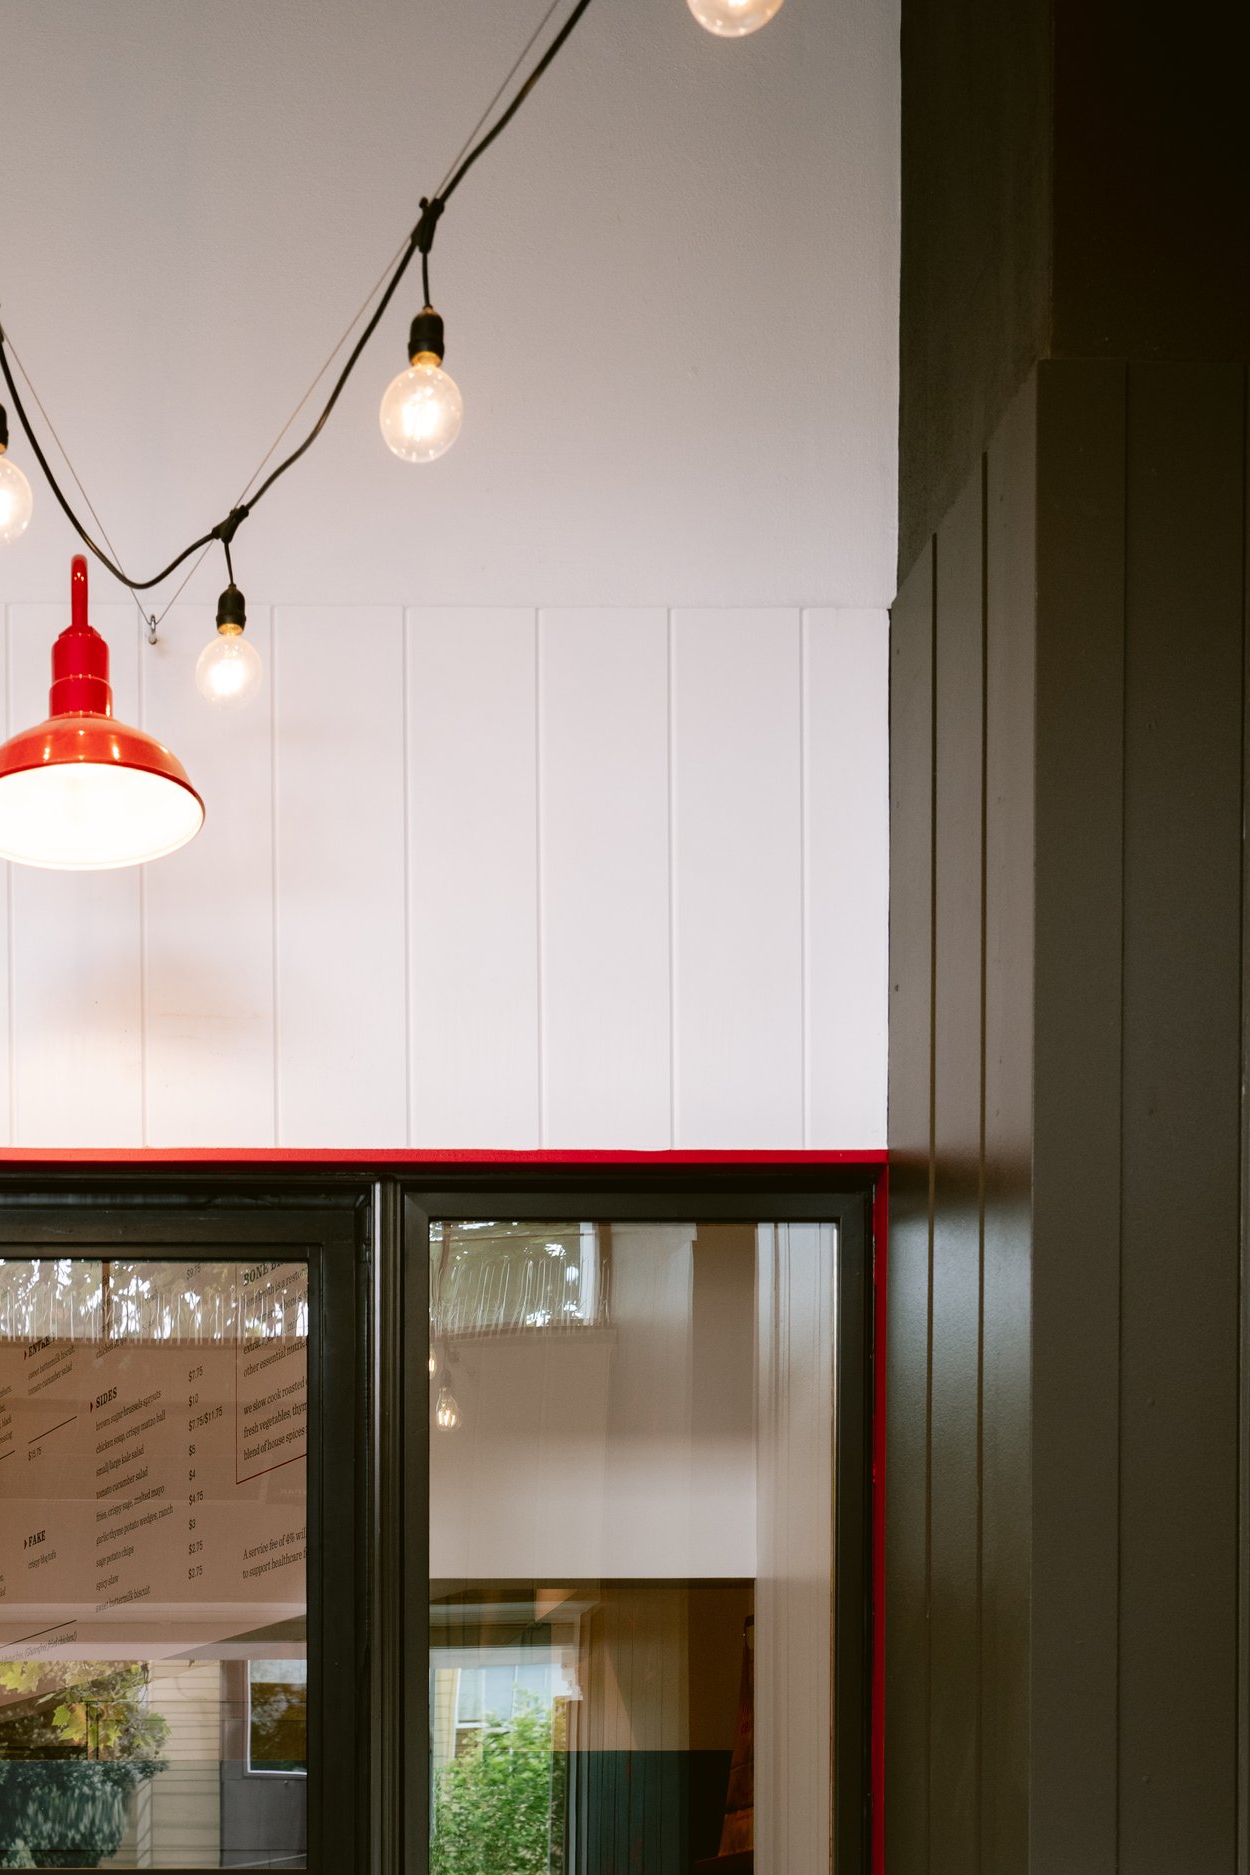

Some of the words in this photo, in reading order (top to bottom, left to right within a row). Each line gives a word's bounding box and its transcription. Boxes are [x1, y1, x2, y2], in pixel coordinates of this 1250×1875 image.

[243, 1363, 259, 1378] other
[260, 1346, 286, 1370] essential
[188, 1366, 204, 1383] $7.75
[96, 1386, 118, 1408] SIDES
[188, 1393, 199, 1408] $10
[243, 1405, 253, 1415] we
[252, 1396, 266, 1410] slow
[267, 1388, 282, 1404] cook
[282, 1376, 305, 1399] roasted
[96, 1418, 111, 1432] brown
[110, 1410, 124, 1424] sugar
[124, 1398, 142, 1417] brussels
[142, 1390, 162, 1408] sprouts
[188, 1406, 223, 1432] $7.75/$11.75
[96, 1437, 114, 1454] chicken
[126, 1424, 140, 1438] crispy
[140, 1417, 157, 1432] matzo
[156, 1409, 166, 1422] ball
[243, 1426, 258, 1438] fresh
[259, 1410, 292, 1431] vegetables,
[122, 1451, 132, 1464] kale
[132, 1444, 144, 1459] salad
[188, 1444, 196, 1458] $5
[243, 1445, 260, 1460] blend
[260, 1440, 268, 1453] of
[268, 1436, 285, 1451] house
[286, 1426, 306, 1444] spices
[113, 1474, 135, 1491] cucumber
[135, 1466, 148, 1481] salad
[188, 1469, 196, 1481] $4
[108, 1504, 122, 1518] crispy
[134, 1489, 151, 1505] malted
[150, 1485, 165, 1498] mayo
[188, 1490, 204, 1506] $4.75
[124, 1520, 140, 1535] potato
[158, 1504, 174, 1518] ranch
[188, 1518, 196, 1530] $3
[28, 1530, 46, 1548] FAKE
[188, 1540, 204, 1556] $2.75
[242, 1548, 248, 1560] A
[248, 1543, 269, 1558] service
[269, 1538, 278, 1551] fee
[278, 1534, 286, 1546] of
[28, 1558, 40, 1570] crispy
[96, 1556, 107, 1568] sage
[106, 1550, 122, 1566] potato
[121, 1544, 135, 1558] chips
[242, 1570, 249, 1580] to
[249, 1562, 270, 1577] support
[270, 1551, 302, 1570] healthcare
[96, 1580, 108, 1592] spicy
[108, 1575, 119, 1586] slaw
[188, 1566, 203, 1580] $2.75
[134, 1585, 150, 1600] biscuit
